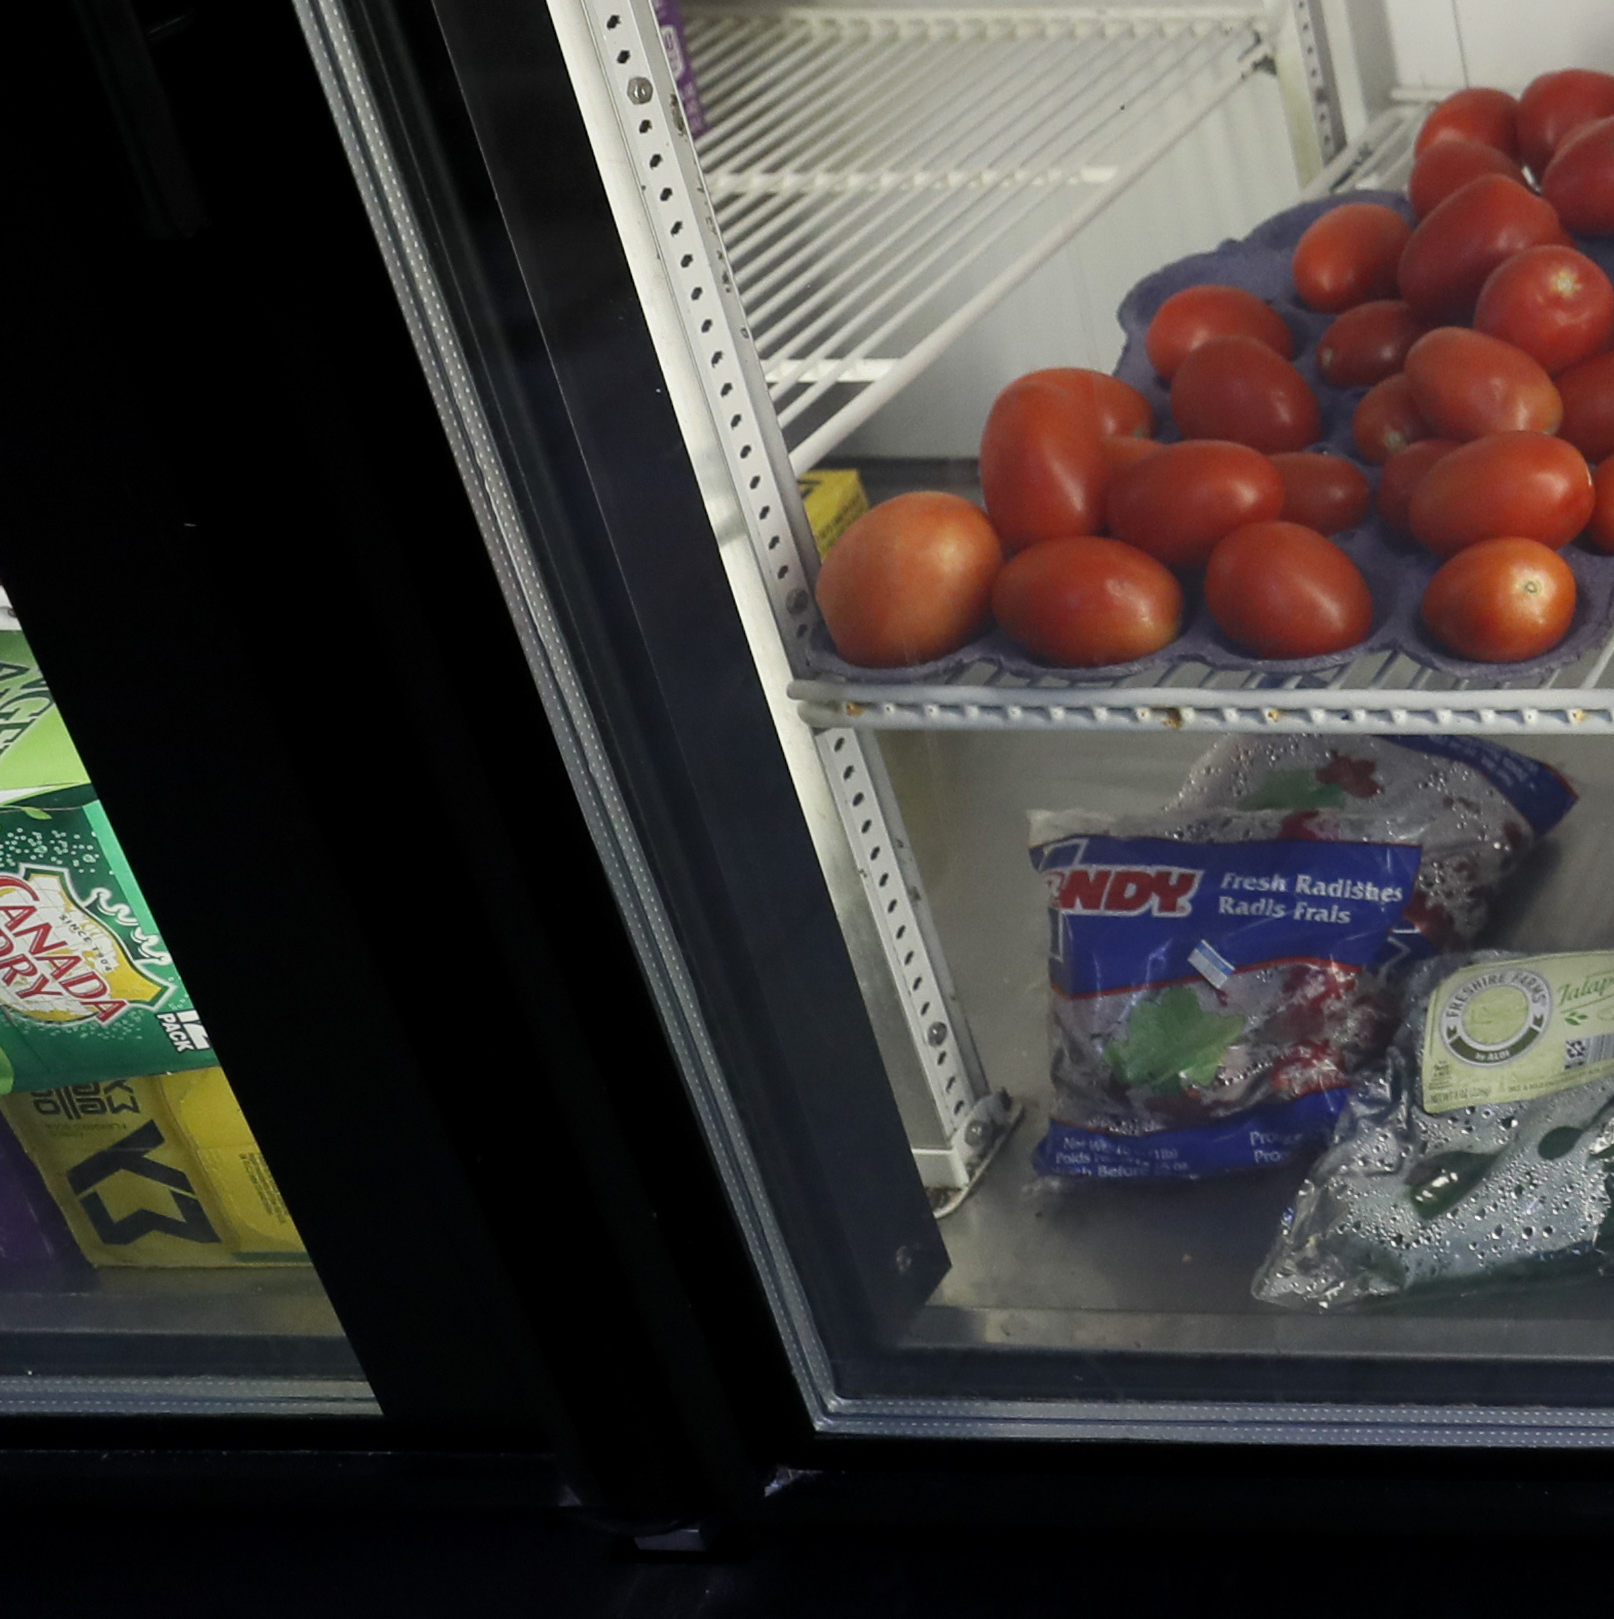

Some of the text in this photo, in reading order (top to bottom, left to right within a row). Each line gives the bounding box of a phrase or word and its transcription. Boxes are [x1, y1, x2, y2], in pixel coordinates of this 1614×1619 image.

[1220, 872, 1404, 904] Fresh Radishes
[1218, 895, 1352, 925] Radis Frais
[59, 914, 113, 972] SINCE 1904
[1446, 973, 1506, 1018] FRESHIRE
[157, 1012, 196, 1053] PACK
[1487, 1049, 1511, 1062] ALDI
